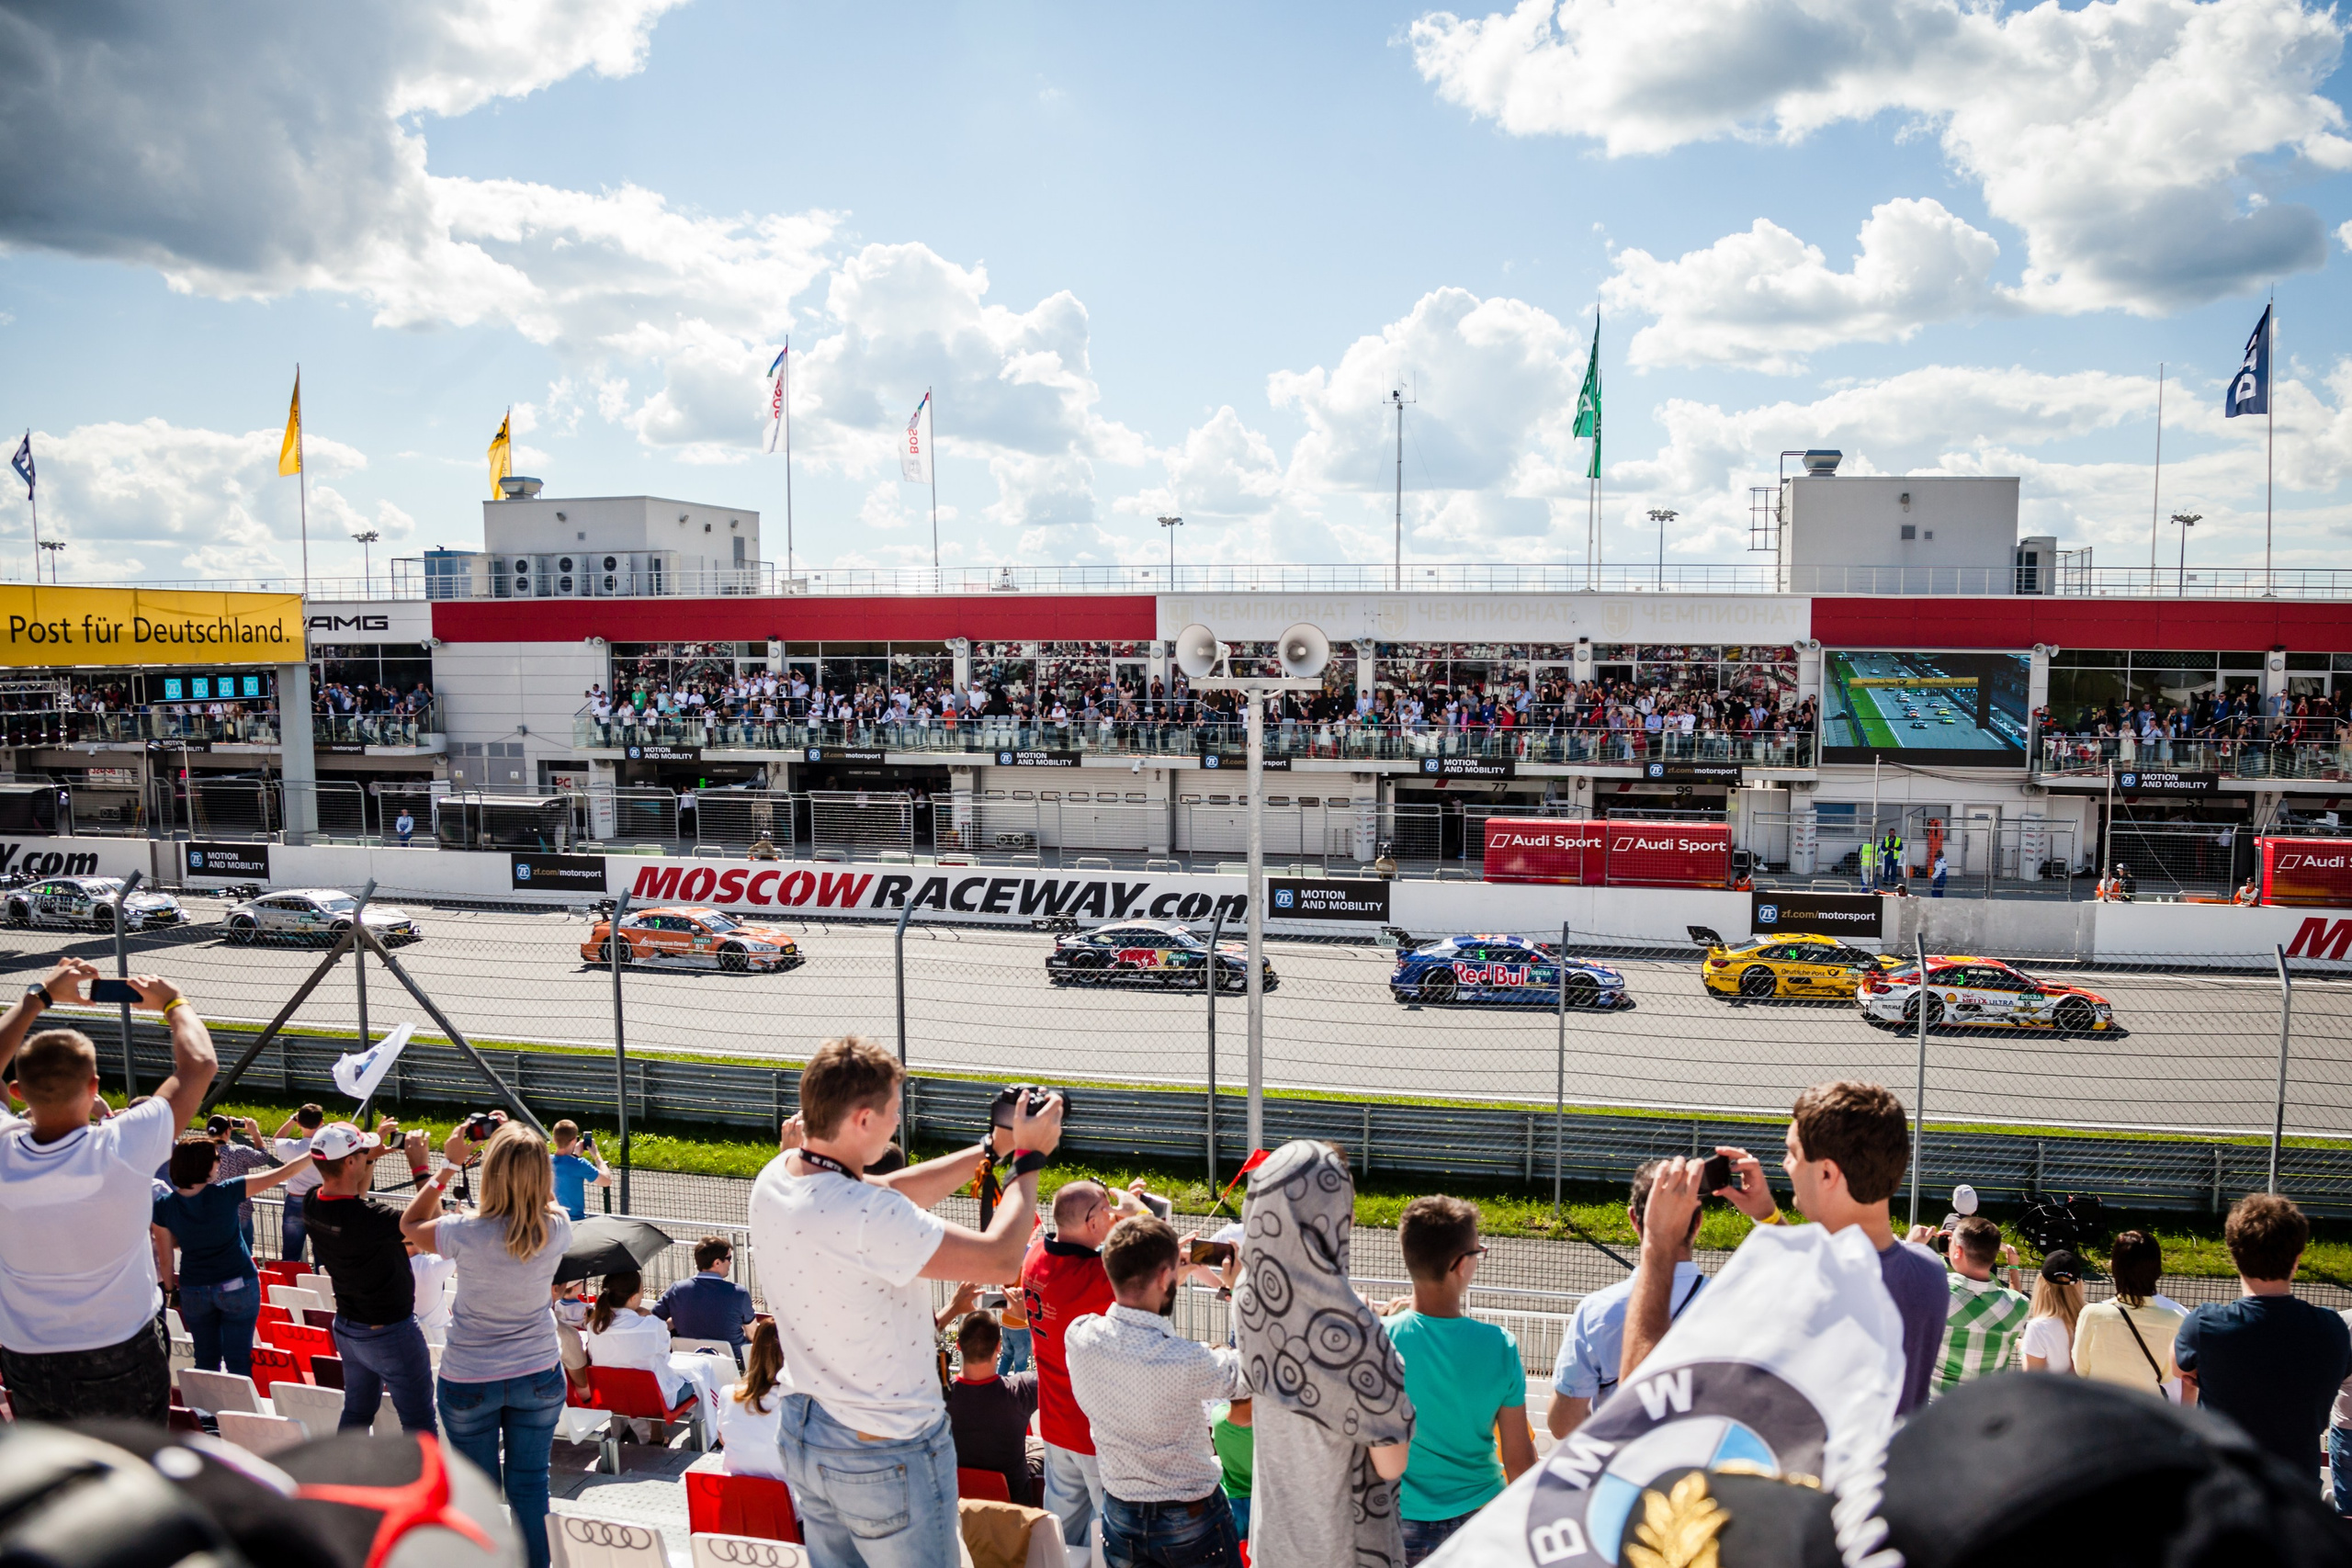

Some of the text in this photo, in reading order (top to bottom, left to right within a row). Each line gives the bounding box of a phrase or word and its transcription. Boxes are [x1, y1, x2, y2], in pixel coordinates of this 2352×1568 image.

[1202, 602, 1351, 621] ЧЕМПИОНАТ
[1418, 602, 1572, 621] ЧЕМПИОНАТ
[1642, 603, 1803, 624] ЧЕМПИОНАТ
[309, 615, 389, 631] AMG
[10, 614, 290, 644] Post für Deutschland.
[823, 751, 881, 761] zf.com/motorsport
[1016, 751, 1047, 760] MOTION
[1035, 759, 1073, 767] MOBILITY
[1221, 758, 1287, 768] zf.com/orsport
[1443, 759, 1478, 767] MOTION
[1444, 765, 1506, 774] AND MOBILITY
[1667, 766, 1737, 776] zf.com/motorsport
[1492, 783, 1508, 792] 77
[1676, 785, 1692, 795] 99
[2164, 781, 2208, 789] MOBILITY
[1511, 834, 1602, 850] Audi Sport
[1635, 837, 1727, 853] Audi Sport
[208, 852, 239, 861] MOTION
[2302, 854, 2344, 868] Audi
[209, 861, 265, 870] AND MOBILITY
[533, 867, 602, 879] zf.com/motorsport
[1301, 889, 1346, 899] MOTION
[1302, 900, 1383, 911] AND MOBILITY
[1781, 909, 1876, 922] zf.com/motorsport
[655, 919, 661, 930] 7
[1478, 950, 1486, 960] 5
[1789, 950, 1796, 960] 4
[1453, 961, 1531, 987] Red Bull
[1957, 974, 1964, 985] 3
